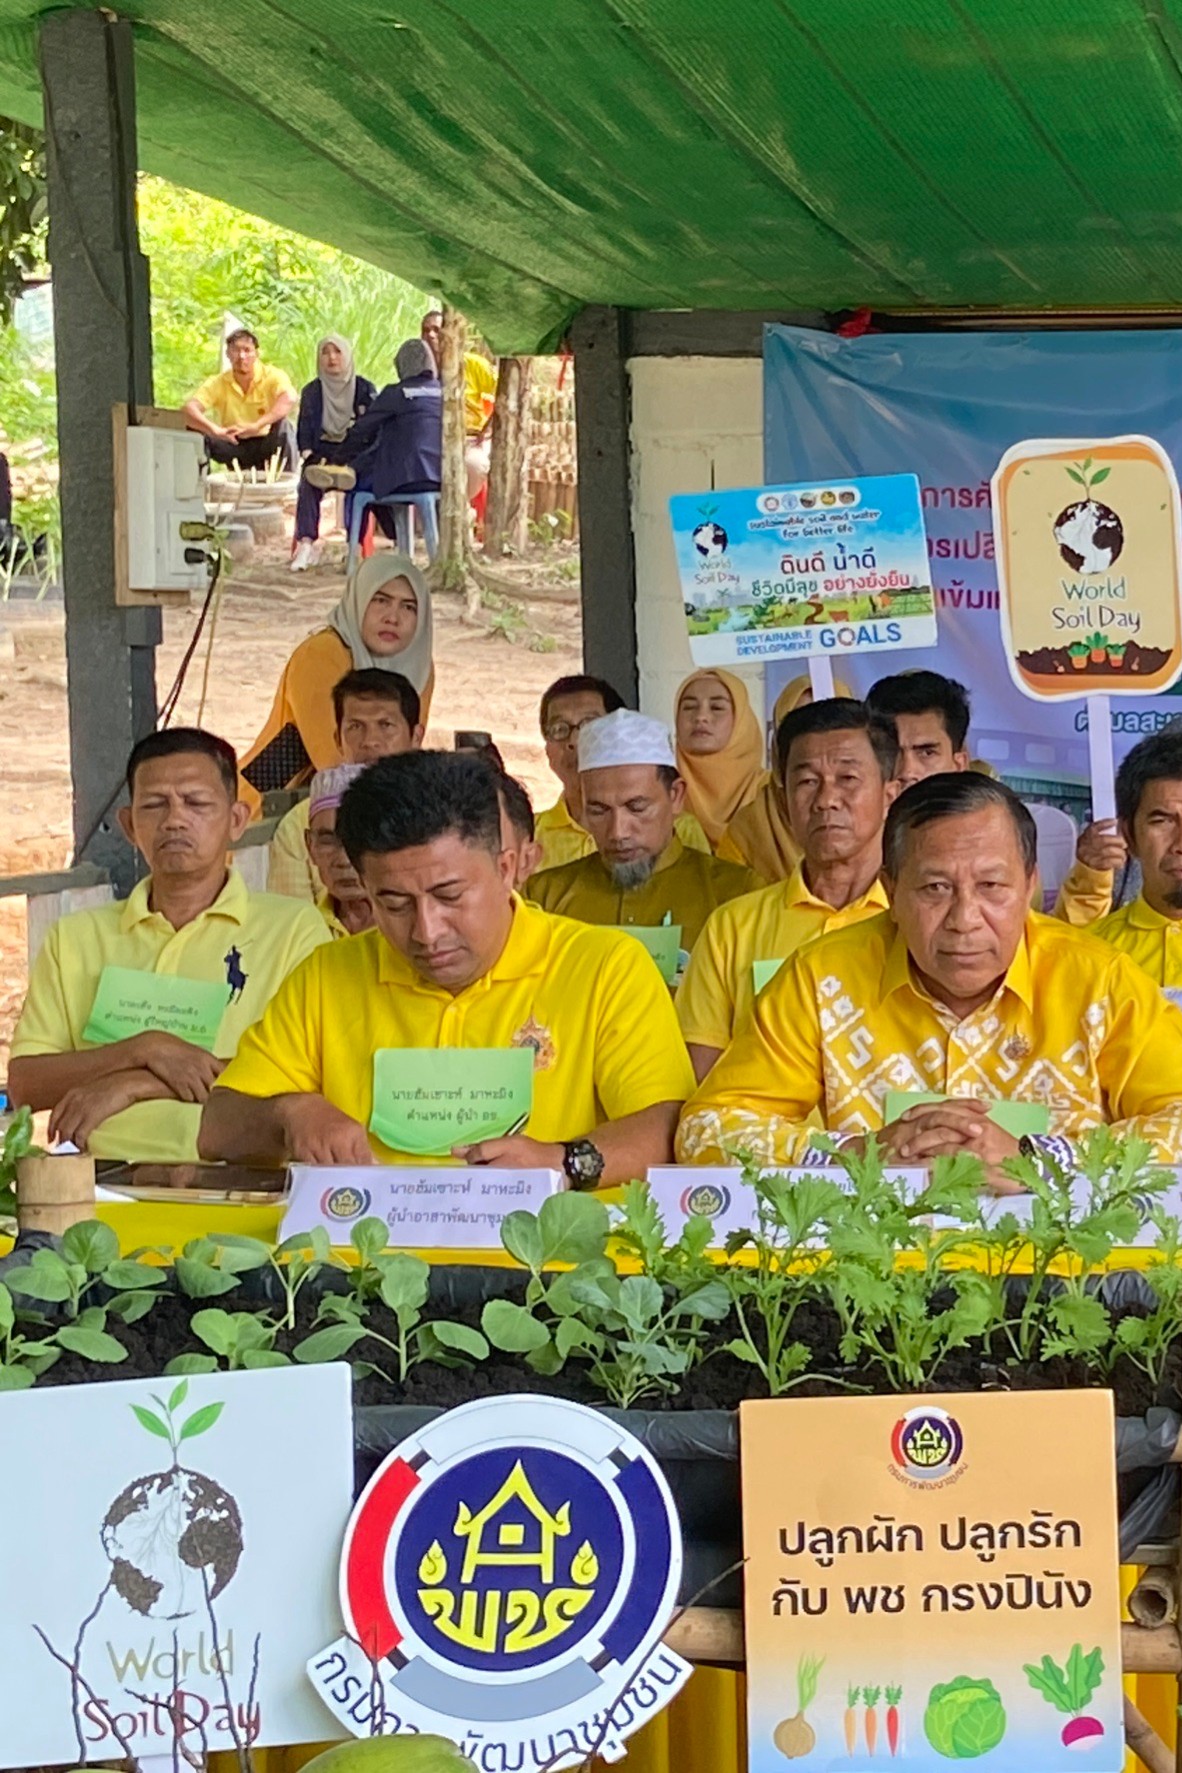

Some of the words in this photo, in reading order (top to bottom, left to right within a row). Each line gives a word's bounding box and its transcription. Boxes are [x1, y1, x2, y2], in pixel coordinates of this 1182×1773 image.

[699, 557, 731, 570] World
[780, 551, 826, 575] ดินดี
[833, 543, 876, 570] น้ำดี
[695, 573, 715, 585] Soil
[718, 572, 741, 586] Day
[752, 577, 817, 598] ชีวิตมีสุข
[823, 569, 911, 592] อย่างยั่งยืน
[1061, 575, 1127, 601] World
[1052, 605, 1093, 630] Soil
[1099, 605, 1141, 633] Day
[736, 629, 813, 645] SUSTAINABLE
[736, 641, 813, 657] DEVELOPMENT
[819, 623, 902, 649] GOALS
[778, 1514, 923, 1568] ปลูกผัก
[939, 1510, 1082, 1563] ปลูกรัก
[772, 1577, 828, 1617] กับ
[844, 1584, 905, 1615] พช
[921, 1570, 1093, 1613] กรงปินัง
[106, 1628, 234, 1684] World
[83, 1692, 165, 1742] Soil
[174, 1688, 261, 1744] Day
